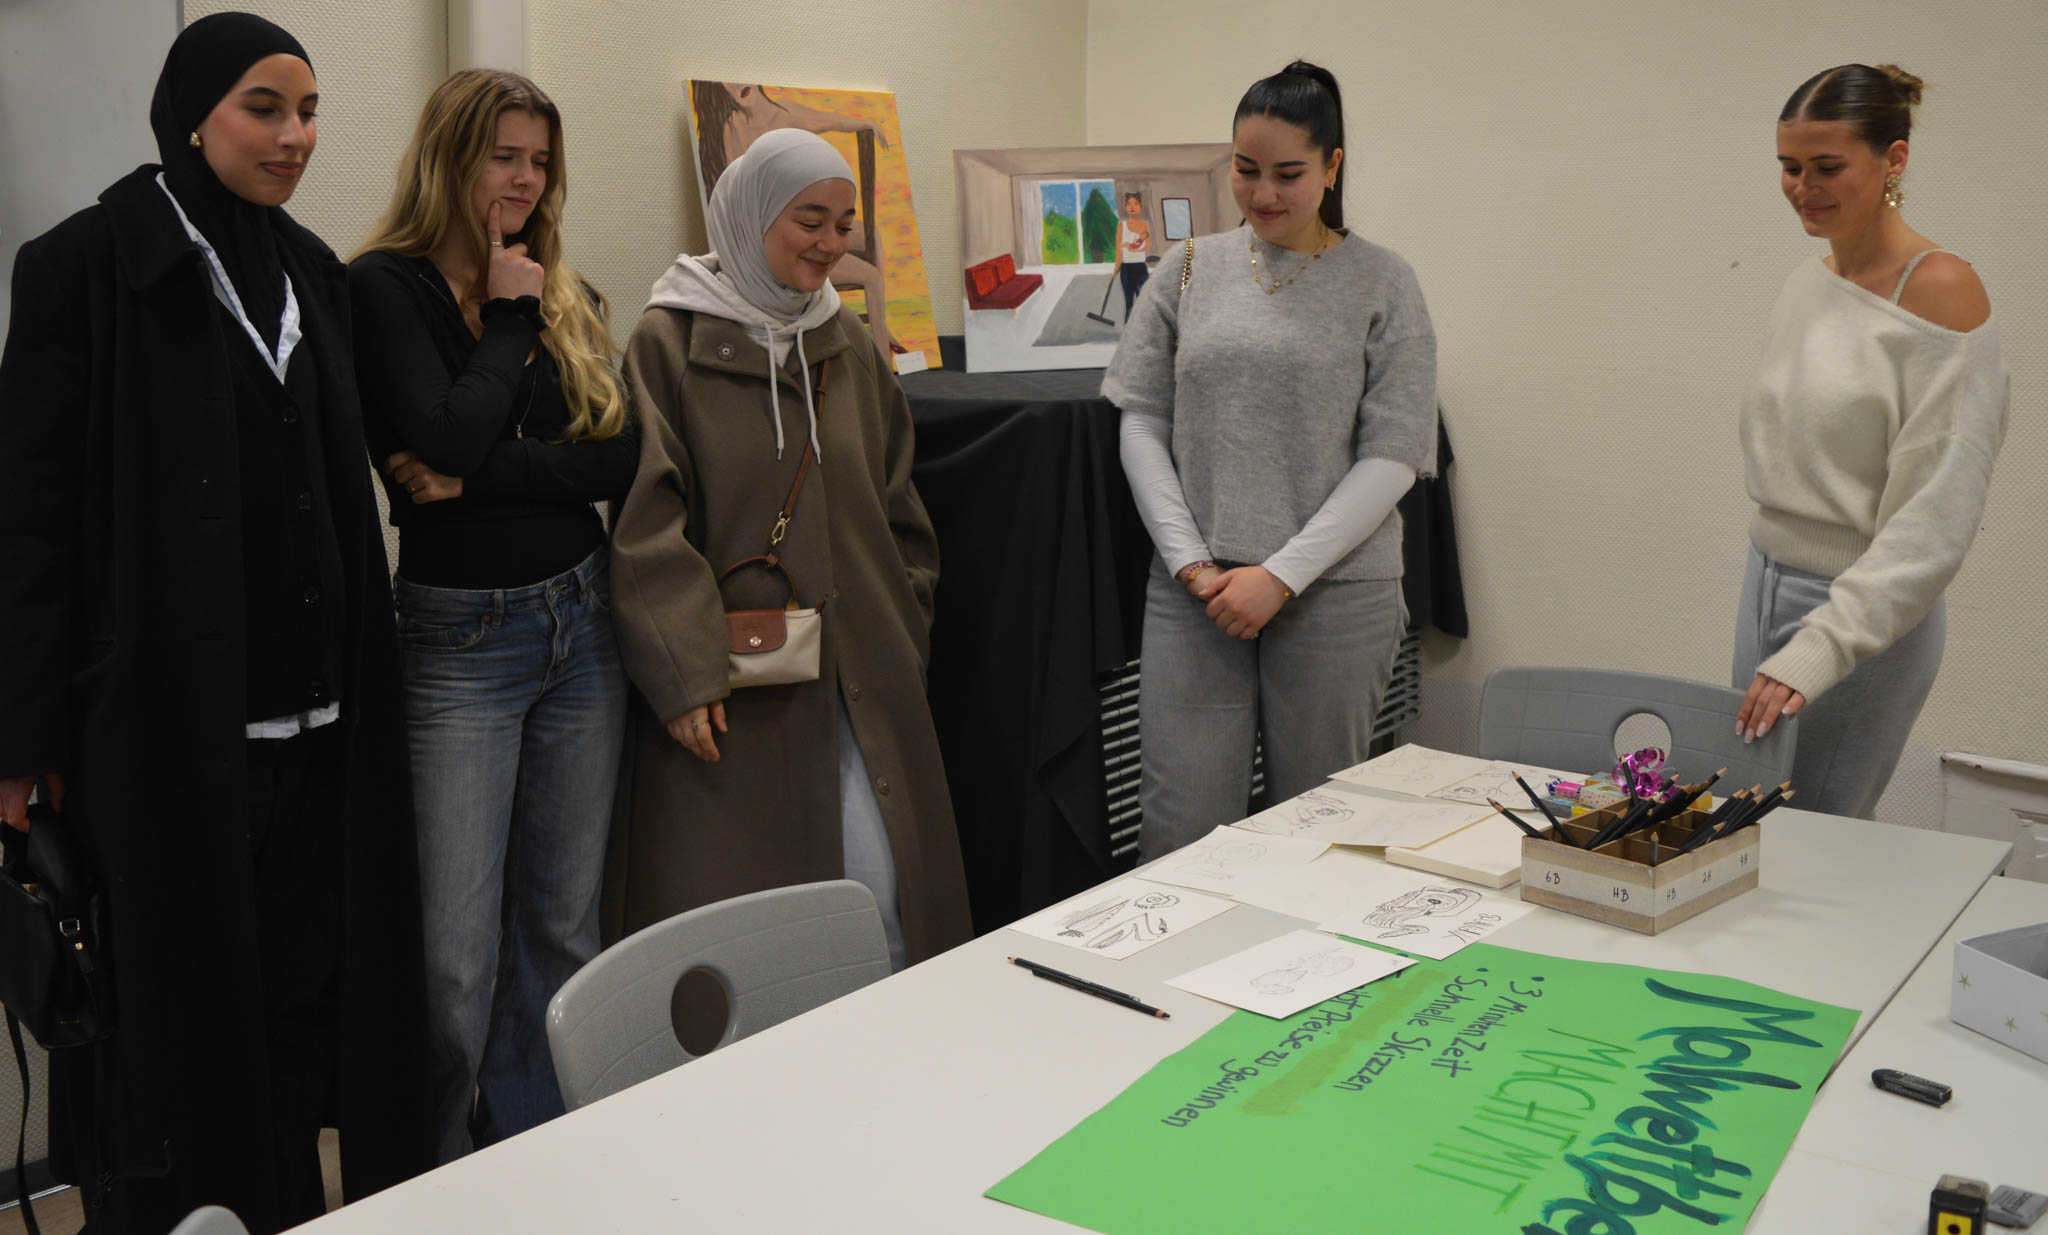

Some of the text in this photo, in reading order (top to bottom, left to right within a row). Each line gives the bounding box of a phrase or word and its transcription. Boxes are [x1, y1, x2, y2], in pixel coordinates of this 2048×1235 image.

[1545, 870, 1561, 885] 6B
[1612, 887, 1630, 903] HB
[1509, 980, 1544, 998] 3
[1278, 1009, 1352, 1050] Preise
[1333, 975, 1488, 1092] Schnelle Skizzen
[1457, 995, 1529, 1037] Minuten
[1254, 1050, 1290, 1067] zu
[1430, 1037, 1487, 1079] Zeit
[1160, 1058, 1260, 1128] gewinnen
[1521, 977, 1824, 1235] Malwettbe
[1413, 1027, 1637, 1216] MACHT MIT
